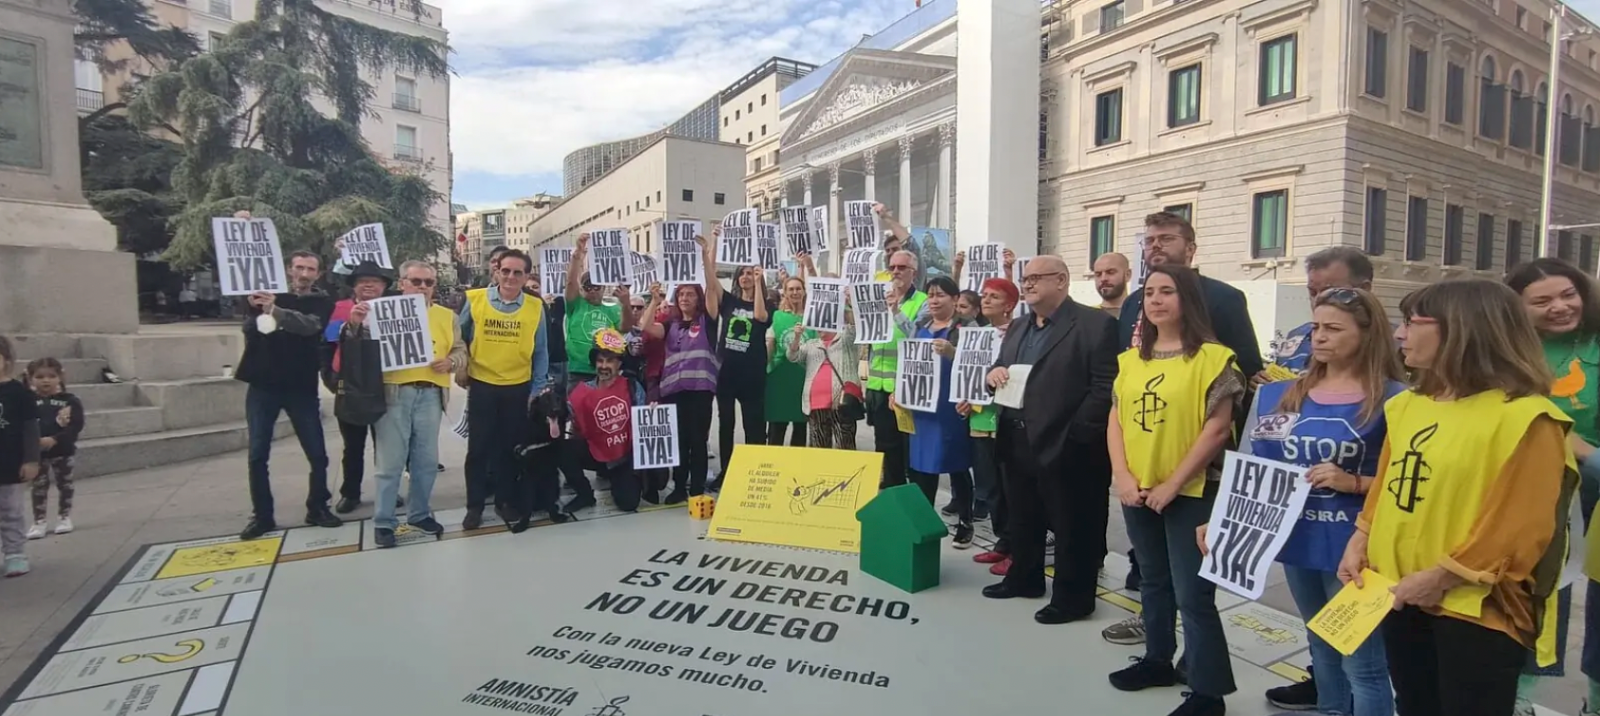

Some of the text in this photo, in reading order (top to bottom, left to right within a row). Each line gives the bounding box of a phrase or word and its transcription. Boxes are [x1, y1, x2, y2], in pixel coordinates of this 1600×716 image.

[850, 136, 861, 148] LOS
[723, 210, 751, 227] LEY DE
[783, 208, 808, 223] LEY DE
[849, 201, 872, 217] LEY DE
[785, 222, 809, 233] VIVIENDA
[850, 215, 873, 227] VIVIENDA
[222, 221, 270, 242] LEY DE
[345, 225, 378, 243] LEY DE
[592, 230, 622, 247] LEY DE
[663, 223, 695, 241] LEY DE
[723, 226, 752, 238] VIVIENDA
[757, 225, 775, 239] EY DE
[851, 225, 875, 248] ¡YA!
[225, 242, 273, 257] VIVIENDA
[346, 240, 381, 254] VIVIENDA
[593, 247, 624, 257] VIVIENDA
[663, 240, 696, 253] VIVIENDA
[722, 238, 752, 263] ¡YA!
[786, 233, 812, 257] ¡YA!
[968, 244, 998, 261] LEY DE
[544, 249, 560, 263] LEY
[757, 248, 778, 270] YA!
[228, 257, 279, 291] ¡YA!
[545, 263, 569, 272] VIVIEND
[595, 257, 627, 283] ¡YA!
[664, 253, 696, 281] ¡YA!
[968, 260, 999, 273] VIVIENDA
[546, 272, 567, 294] ¡YA
[855, 283, 887, 302] LEY DE
[374, 298, 417, 321] LEY DE
[807, 301, 839, 329] ¡YA!
[858, 300, 888, 314] VIVIENDA
[377, 318, 422, 335] VIVIENDA
[484, 318, 521, 329] AMNISTÍA
[860, 313, 888, 341] ¡YA!
[381, 331, 427, 368] ¡YA!
[962, 330, 995, 351] LEY DE
[903, 341, 934, 362] LEY DE
[960, 351, 993, 366] VIVIENDA
[903, 360, 934, 375] VIVIENDA
[901, 374, 934, 408] ¡YA!
[597, 402, 625, 421] STOP
[637, 407, 670, 426] LEY DE
[606, 432, 628, 447] PAH
[638, 425, 672, 437] VIVIENDA
[639, 436, 673, 466] ¡YA!
[1283, 435, 1359, 465] STOP
[1230, 458, 1299, 509] LEY DE
[1225, 493, 1286, 534] VIVIENDA
[1299, 509, 1349, 523] SIRA
[1210, 519, 1276, 592] ¡YA!
[648, 549, 850, 586] LA VIVIENDA
[619, 568, 921, 626] ES UN DERECHO,
[584, 591, 840, 643] NO UN JUEGO
[552, 625, 891, 689] Con la nueva Ley de Vivienda
[527, 644, 768, 694] nos jugamos mucho.
[476, 678, 580, 707] AMNISTÍA
[462, 693, 565, 716] INTERNACIONAL
